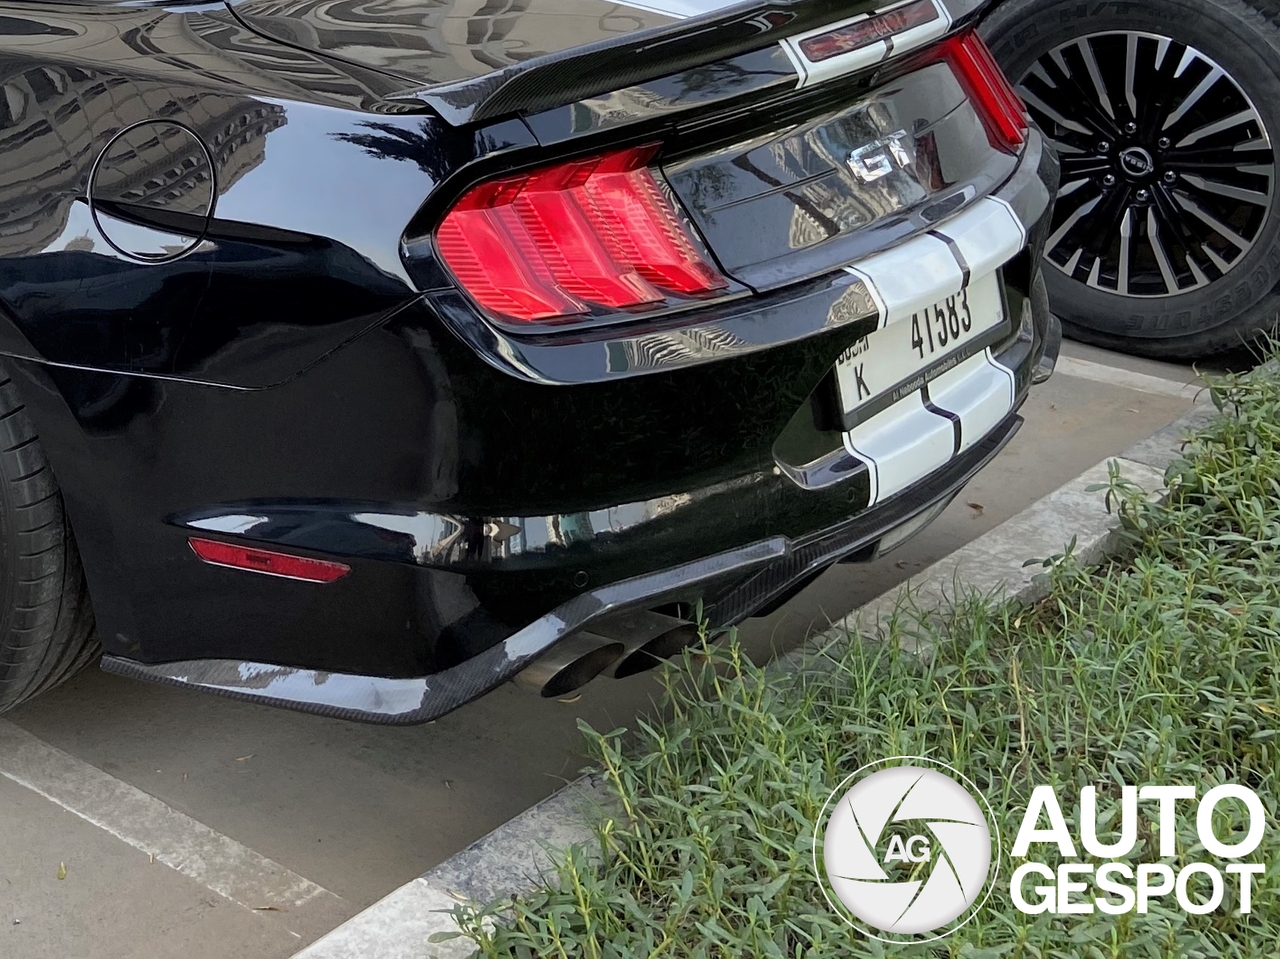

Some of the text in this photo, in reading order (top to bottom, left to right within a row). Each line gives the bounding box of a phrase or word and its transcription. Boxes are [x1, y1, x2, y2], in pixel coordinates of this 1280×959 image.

[846, 128, 908, 183] GT
[911, 287, 972, 360] 41583
[854, 362, 871, 401] K
